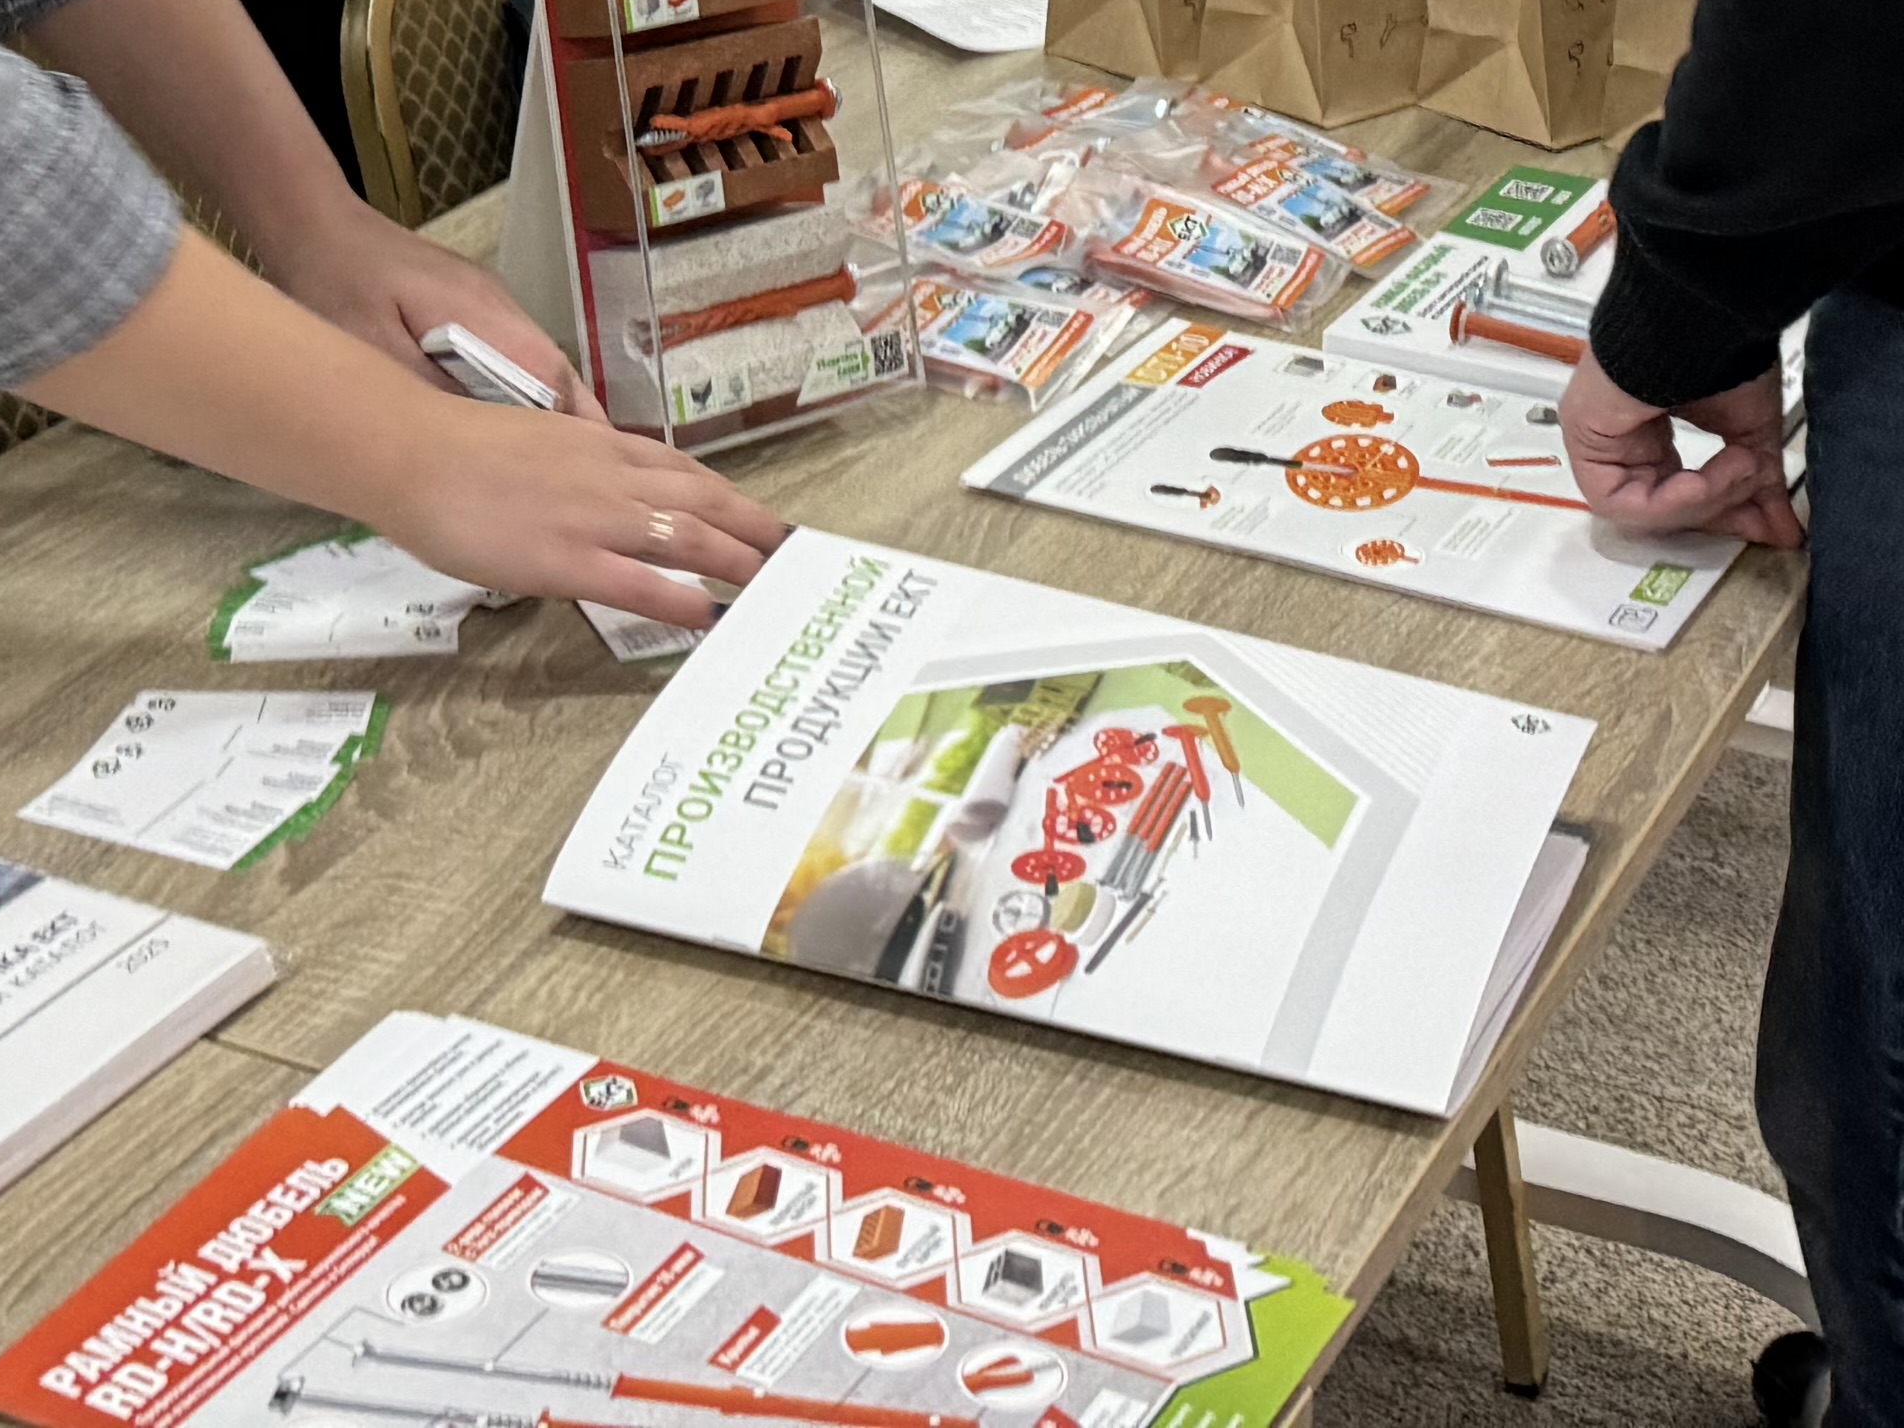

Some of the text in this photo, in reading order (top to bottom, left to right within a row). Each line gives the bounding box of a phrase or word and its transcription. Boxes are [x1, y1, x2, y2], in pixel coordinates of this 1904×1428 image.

[642, 554, 892, 882] ПРОИЗВОДСТВЕННОЙ
[742, 618, 904, 811] ПРОДУКЦИИ
[38, 1259, 218, 1399] РАМНЫЙ
[197, 1156, 351, 1275] ДЮБЕЛЬ
[330, 1152, 417, 1220] NEW
